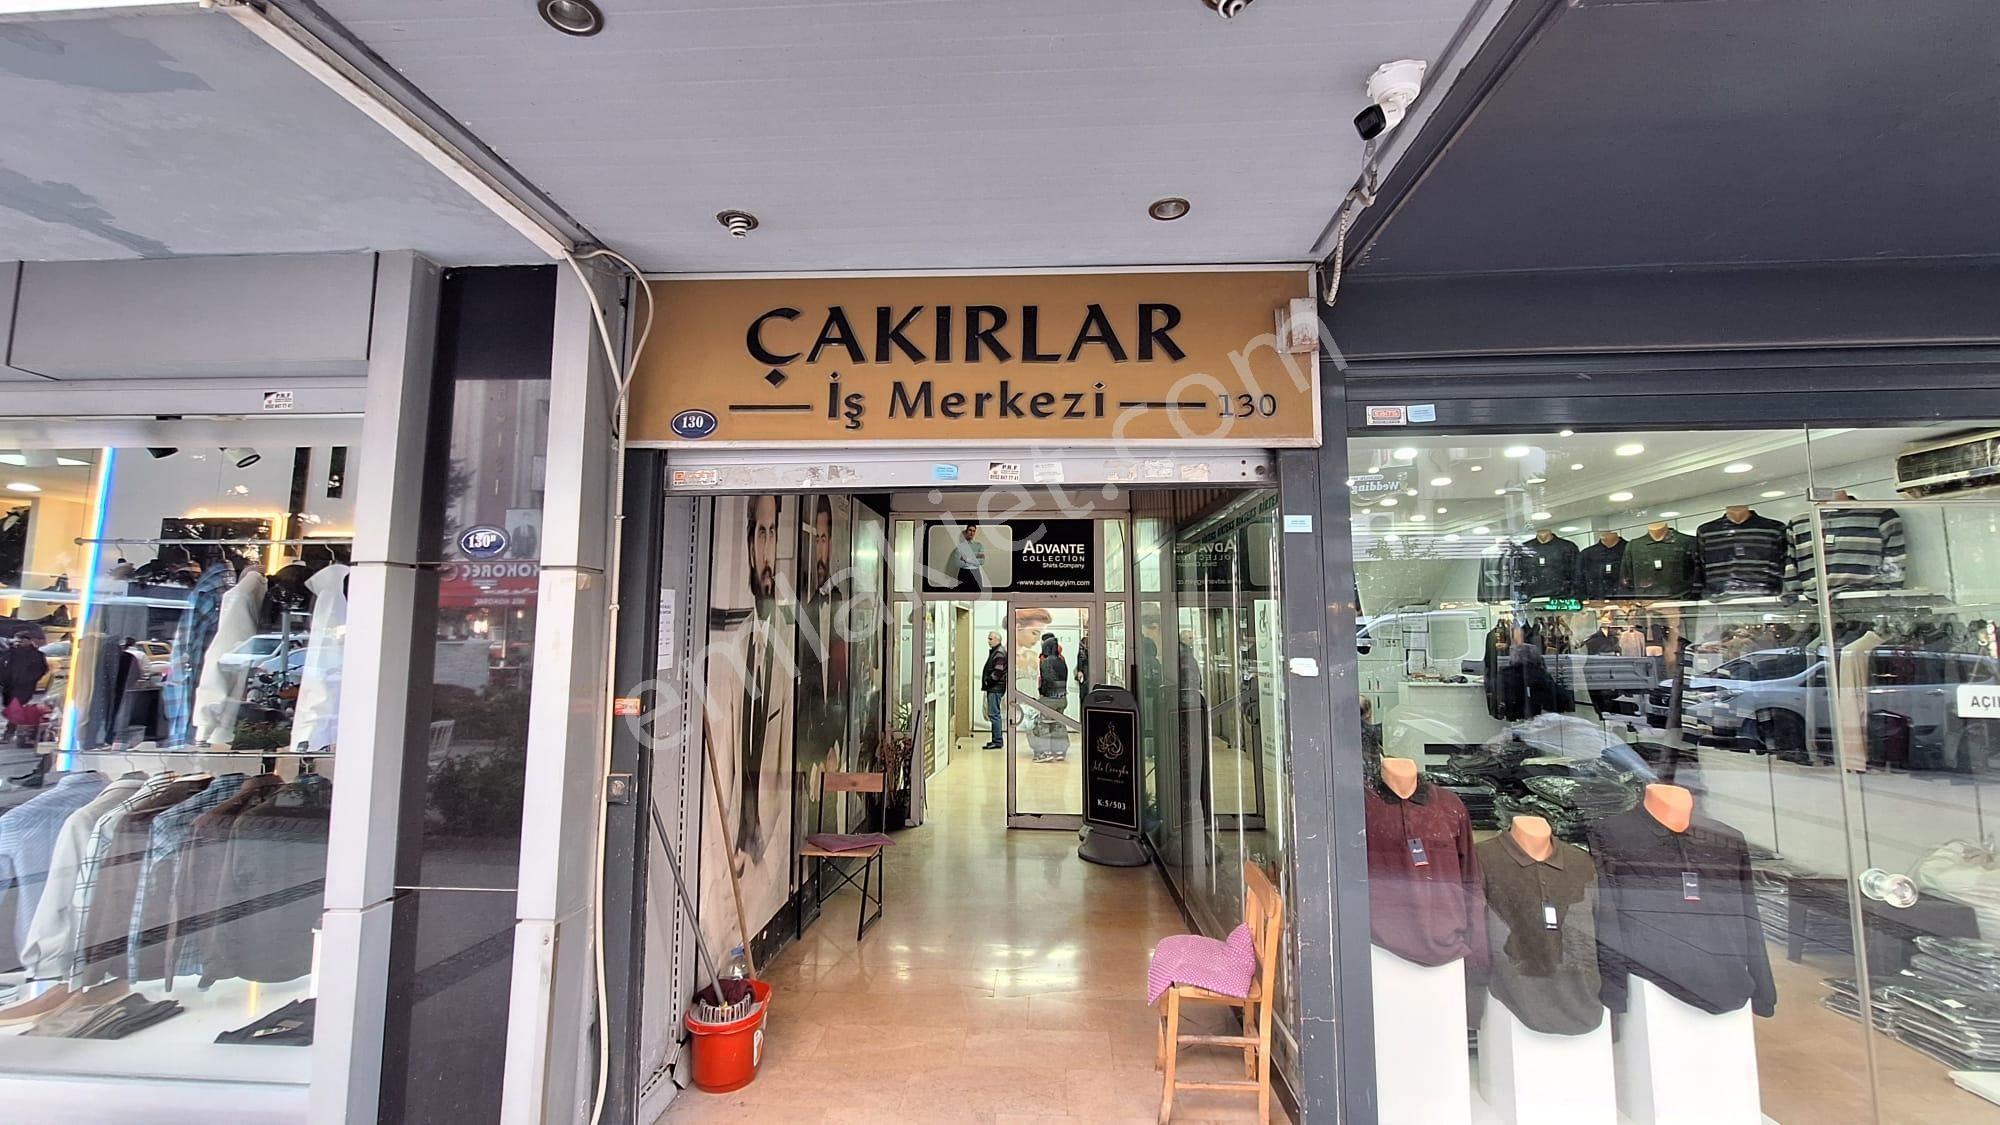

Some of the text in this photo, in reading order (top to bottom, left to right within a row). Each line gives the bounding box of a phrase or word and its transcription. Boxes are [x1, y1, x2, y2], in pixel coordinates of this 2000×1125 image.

[745, 302, 1187, 388] ÇAKIRLAR
[827, 370, 1278, 431] İş Merkezi 130
[682, 415, 704, 429] 130
[1022, 539, 1085, 554] ADVANTE
